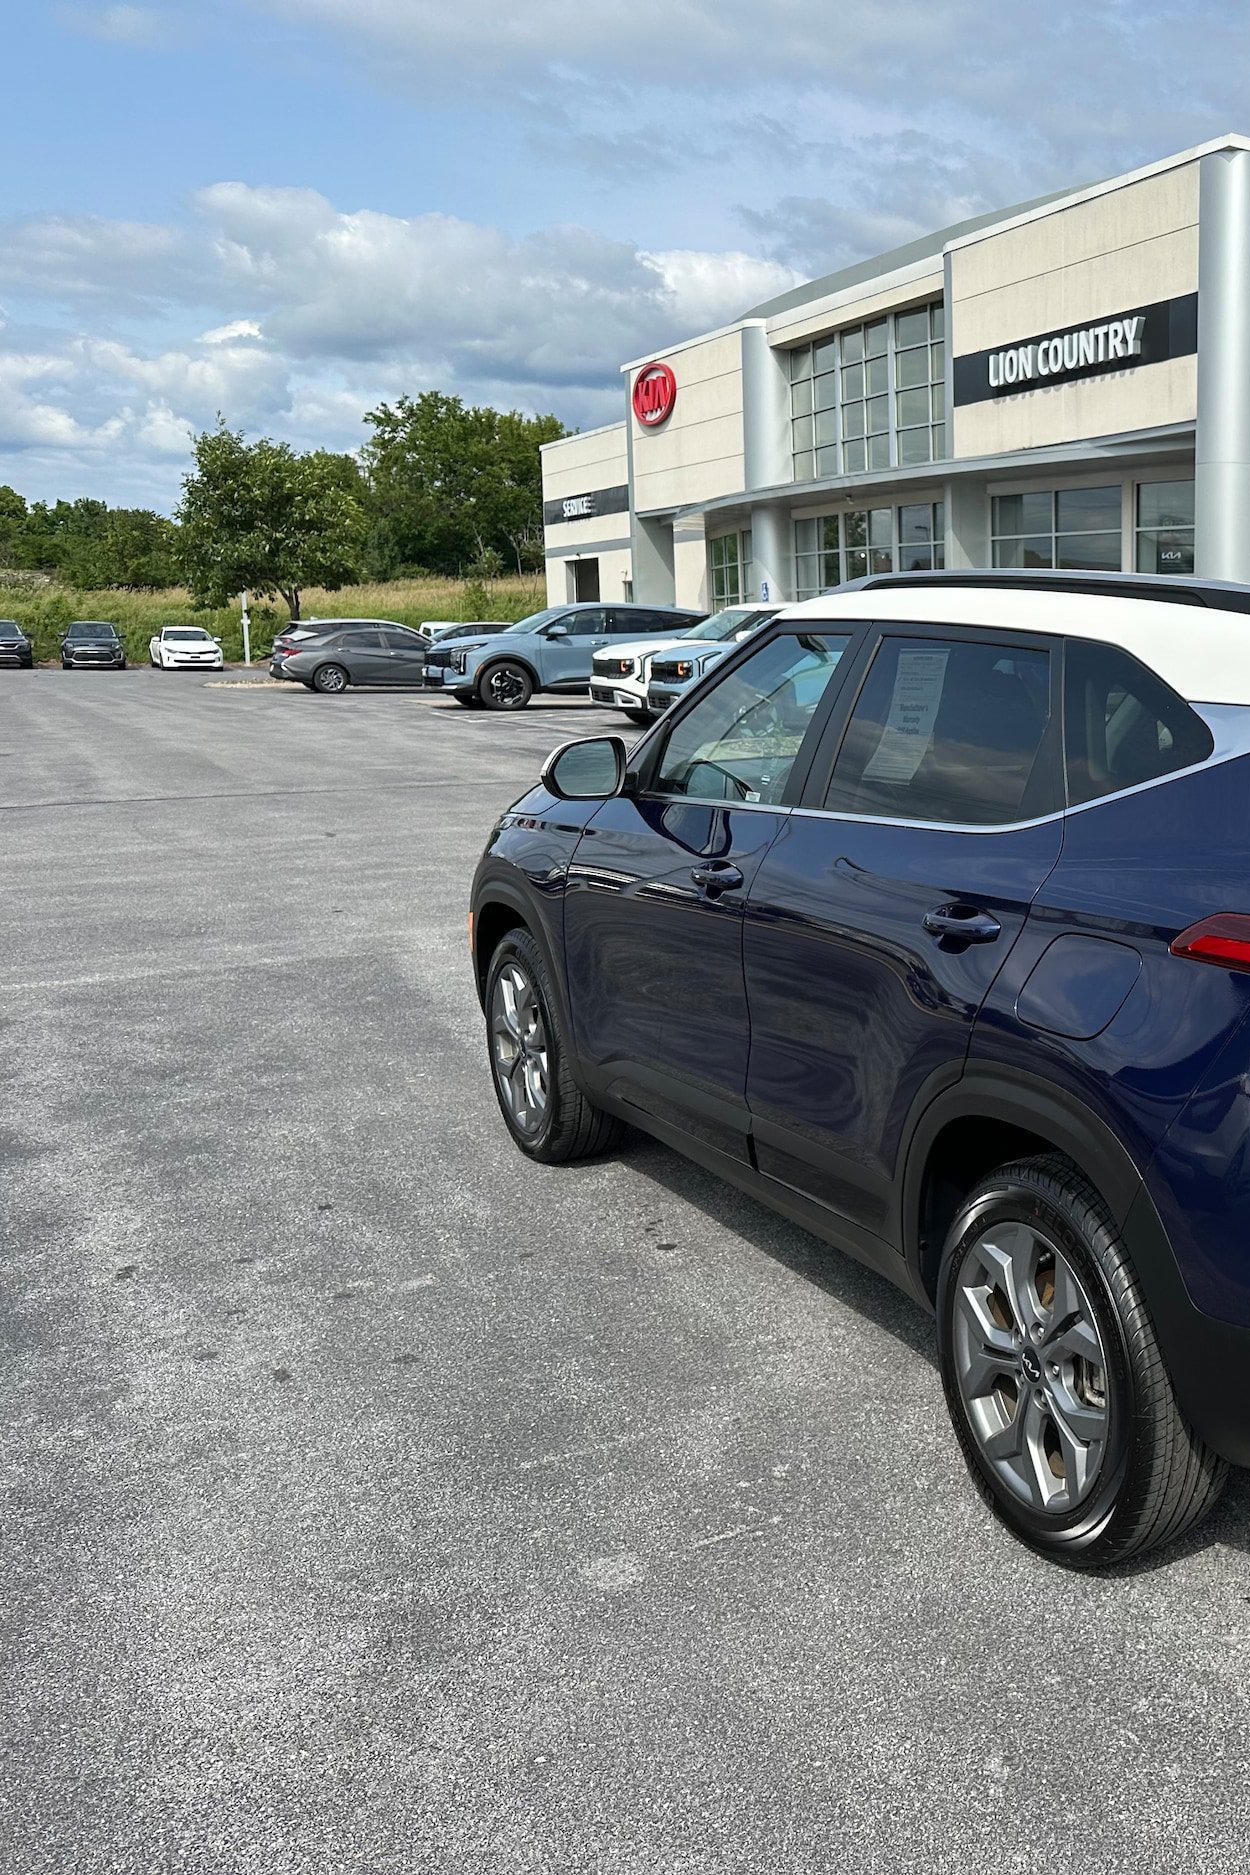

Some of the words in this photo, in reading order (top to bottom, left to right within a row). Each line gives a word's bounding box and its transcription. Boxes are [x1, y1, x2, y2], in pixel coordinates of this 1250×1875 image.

[989, 344, 1037, 387] LION
[1037, 316, 1146, 376] COUNTRY
[562, 496, 593, 518] SERVICE
